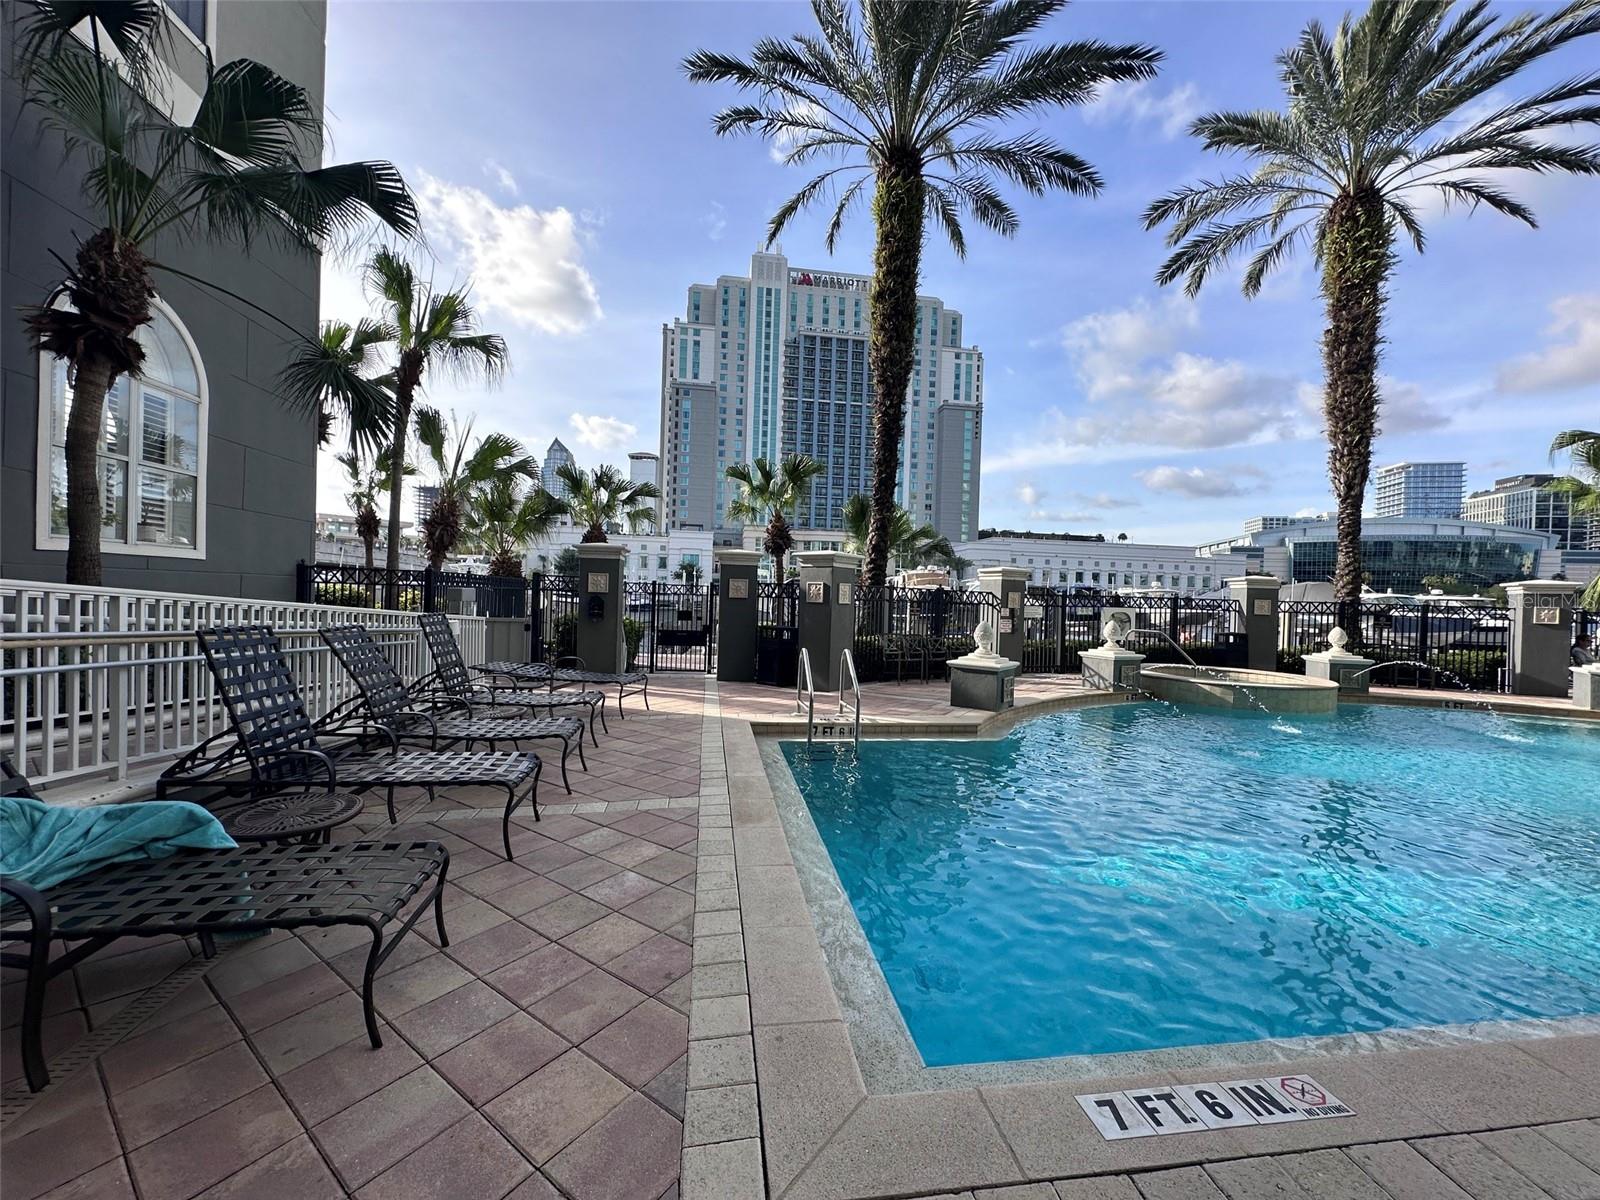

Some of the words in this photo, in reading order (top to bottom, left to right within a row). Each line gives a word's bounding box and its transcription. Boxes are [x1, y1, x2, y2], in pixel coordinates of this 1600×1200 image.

[814, 273, 868, 290] MARRIOTT
[813, 725, 818, 736] 7
[823, 726, 834, 736] FT
[1096, 1098, 1128, 1131] 7
[1132, 1092, 1198, 1127] FT.
[1194, 1090, 1233, 1120] 6
[1229, 1084, 1296, 1116] IN.
[1301, 1107, 1320, 1117] NO
[1315, 1104, 1350, 1116] DIVING
